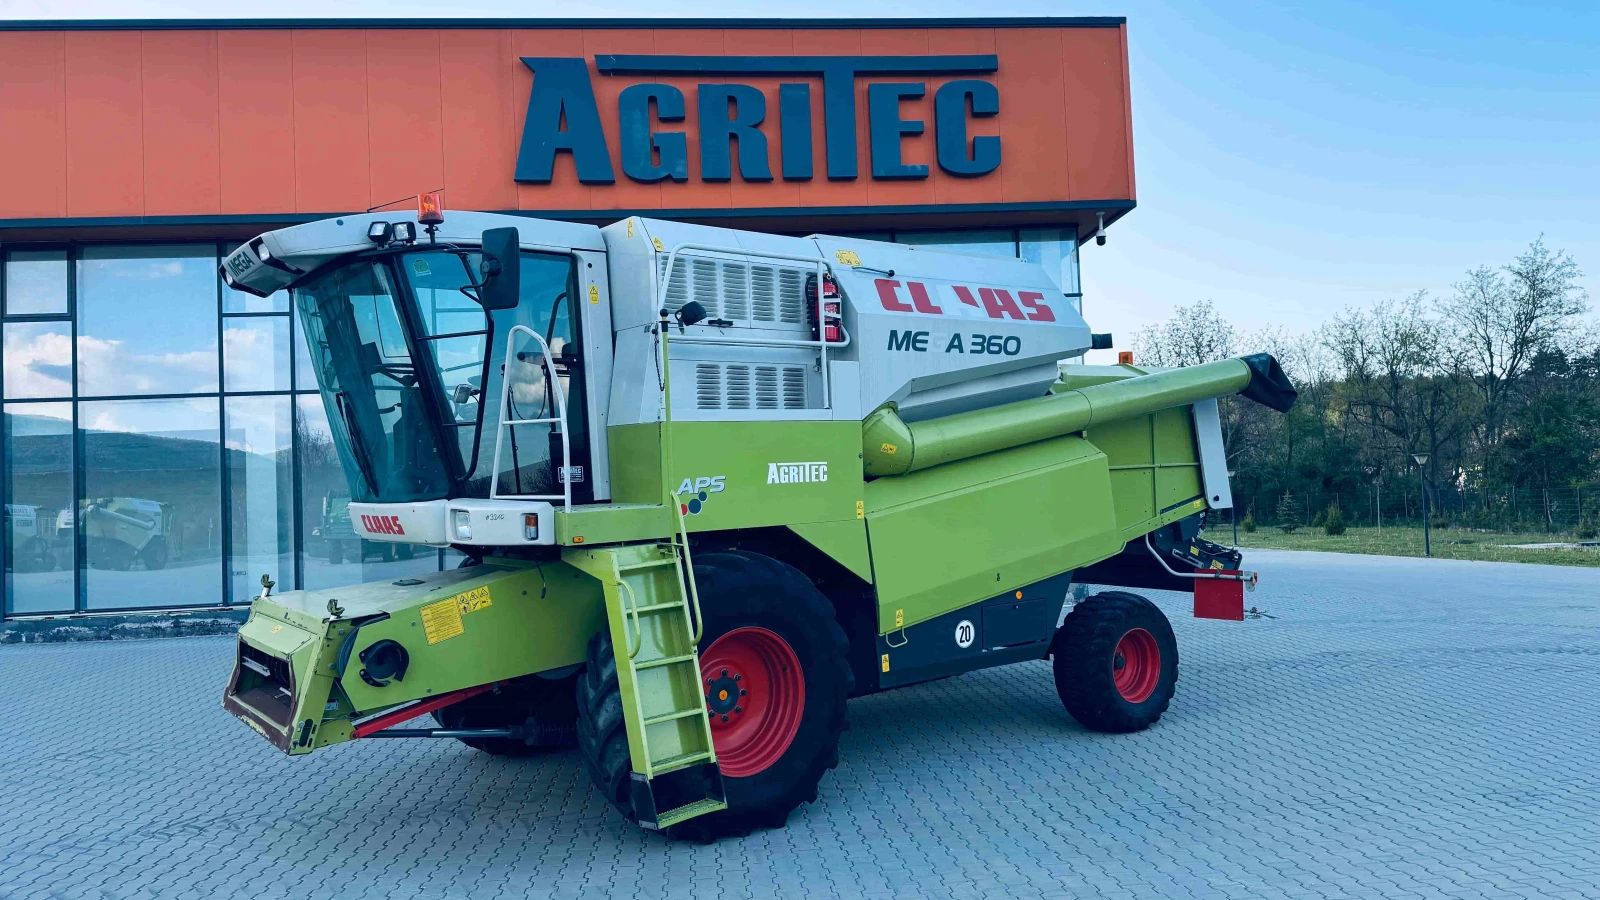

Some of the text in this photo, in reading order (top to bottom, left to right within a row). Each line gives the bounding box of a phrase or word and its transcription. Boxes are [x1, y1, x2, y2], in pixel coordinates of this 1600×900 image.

[513, 54, 1001, 184] AGRITEC
[227, 251, 256, 277] MEGA
[887, 329, 1021, 356] MEA 360
[767, 461, 828, 484] AGRITEC
[676, 475, 726, 496] APS
[361, 514, 405, 535] CLAAS
[959, 625, 971, 643] 20
